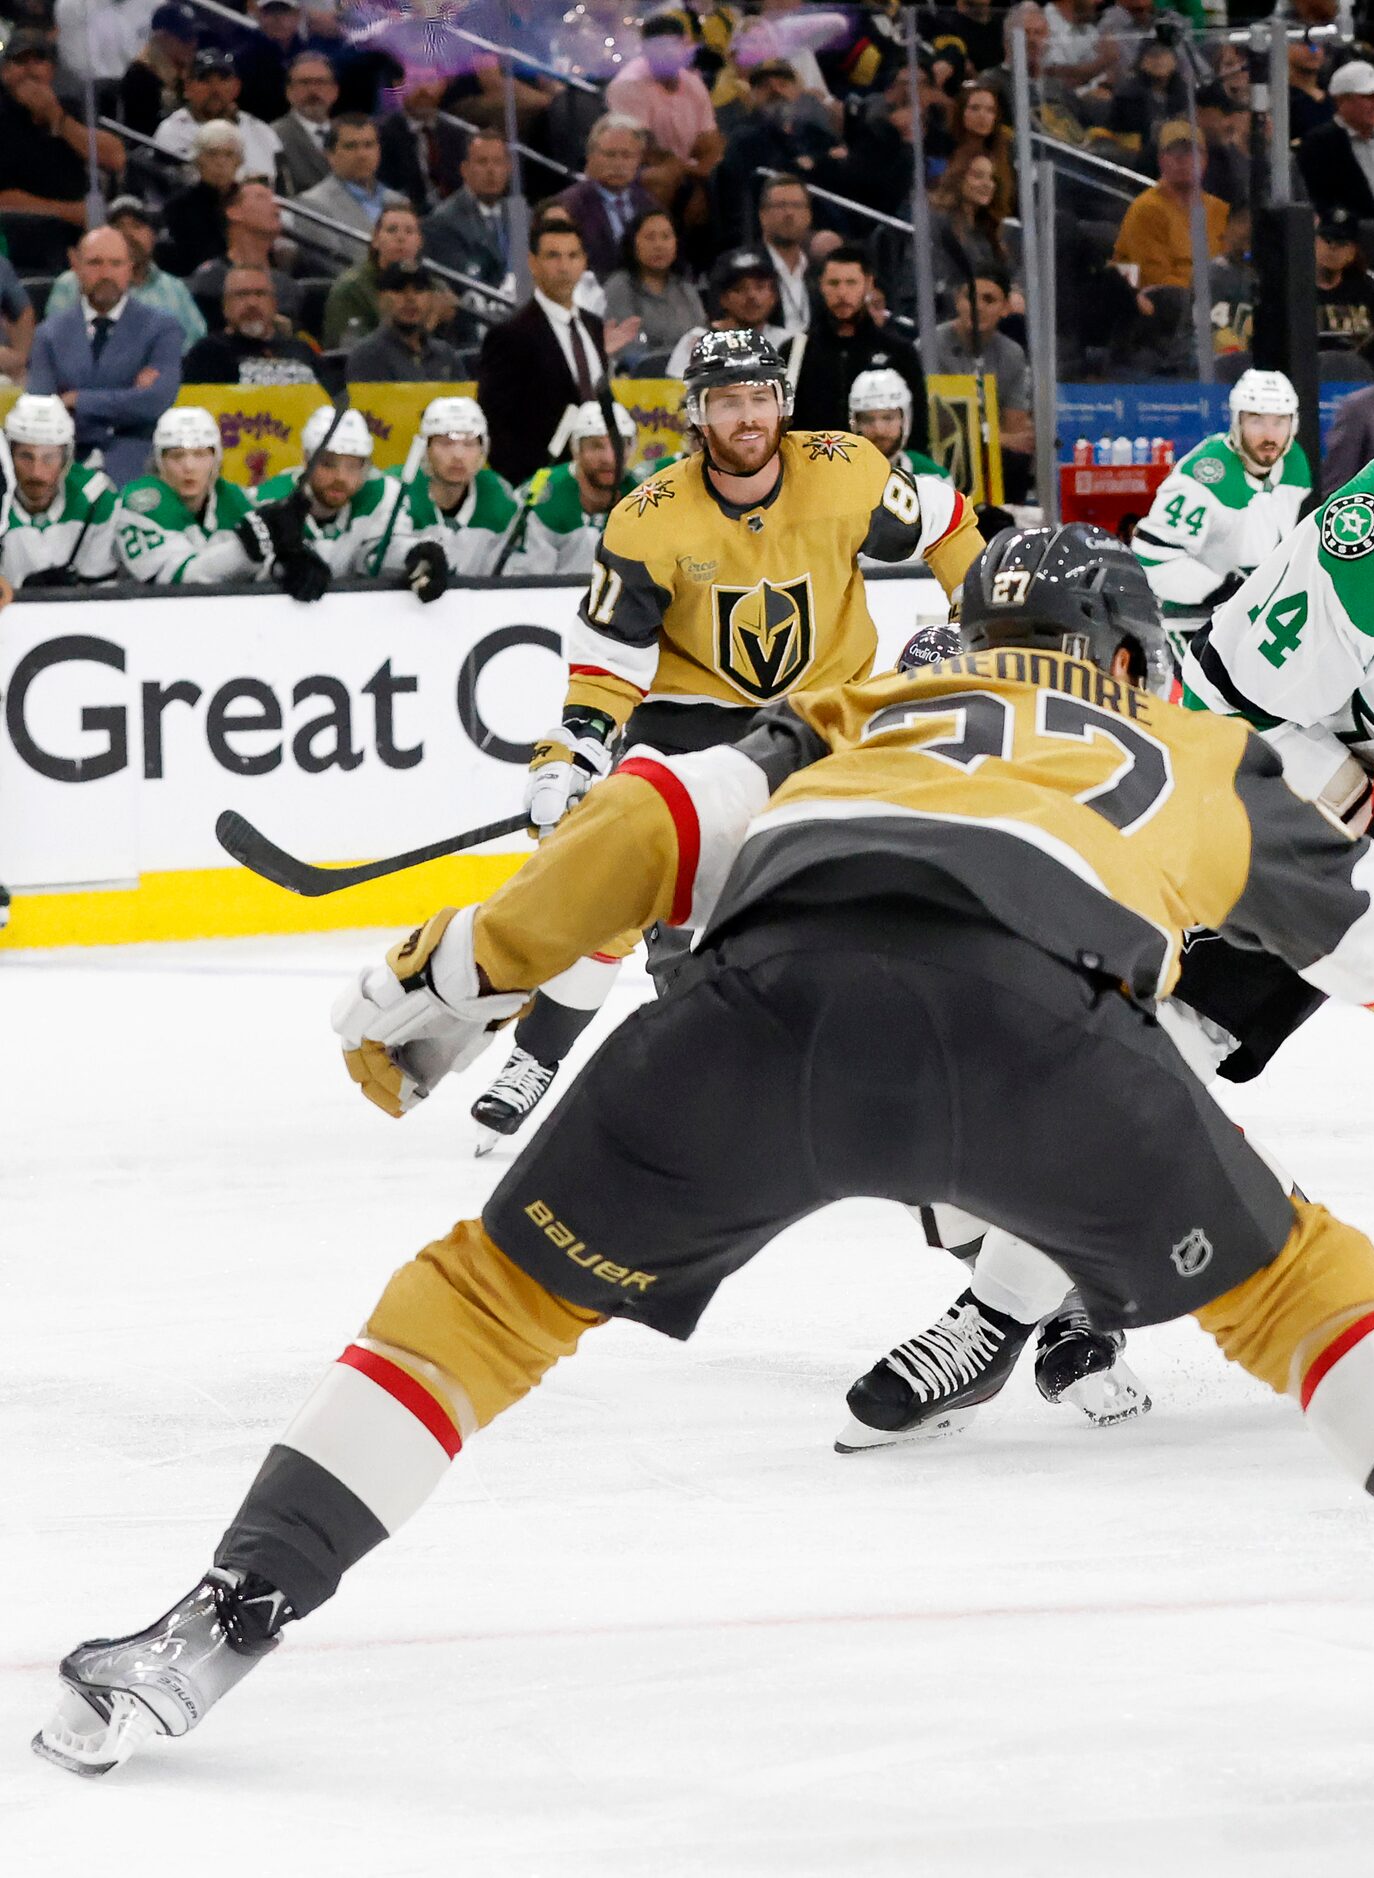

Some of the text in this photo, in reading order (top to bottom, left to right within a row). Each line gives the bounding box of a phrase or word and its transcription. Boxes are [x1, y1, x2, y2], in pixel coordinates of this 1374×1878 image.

[883, 470, 921, 525] 8
[1165, 495, 1206, 536] 44
[991, 571, 1031, 605] 27
[6, 635, 424, 783] Great
[860, 689, 1176, 838] 27
[523, 1199, 657, 1292] BAUER
